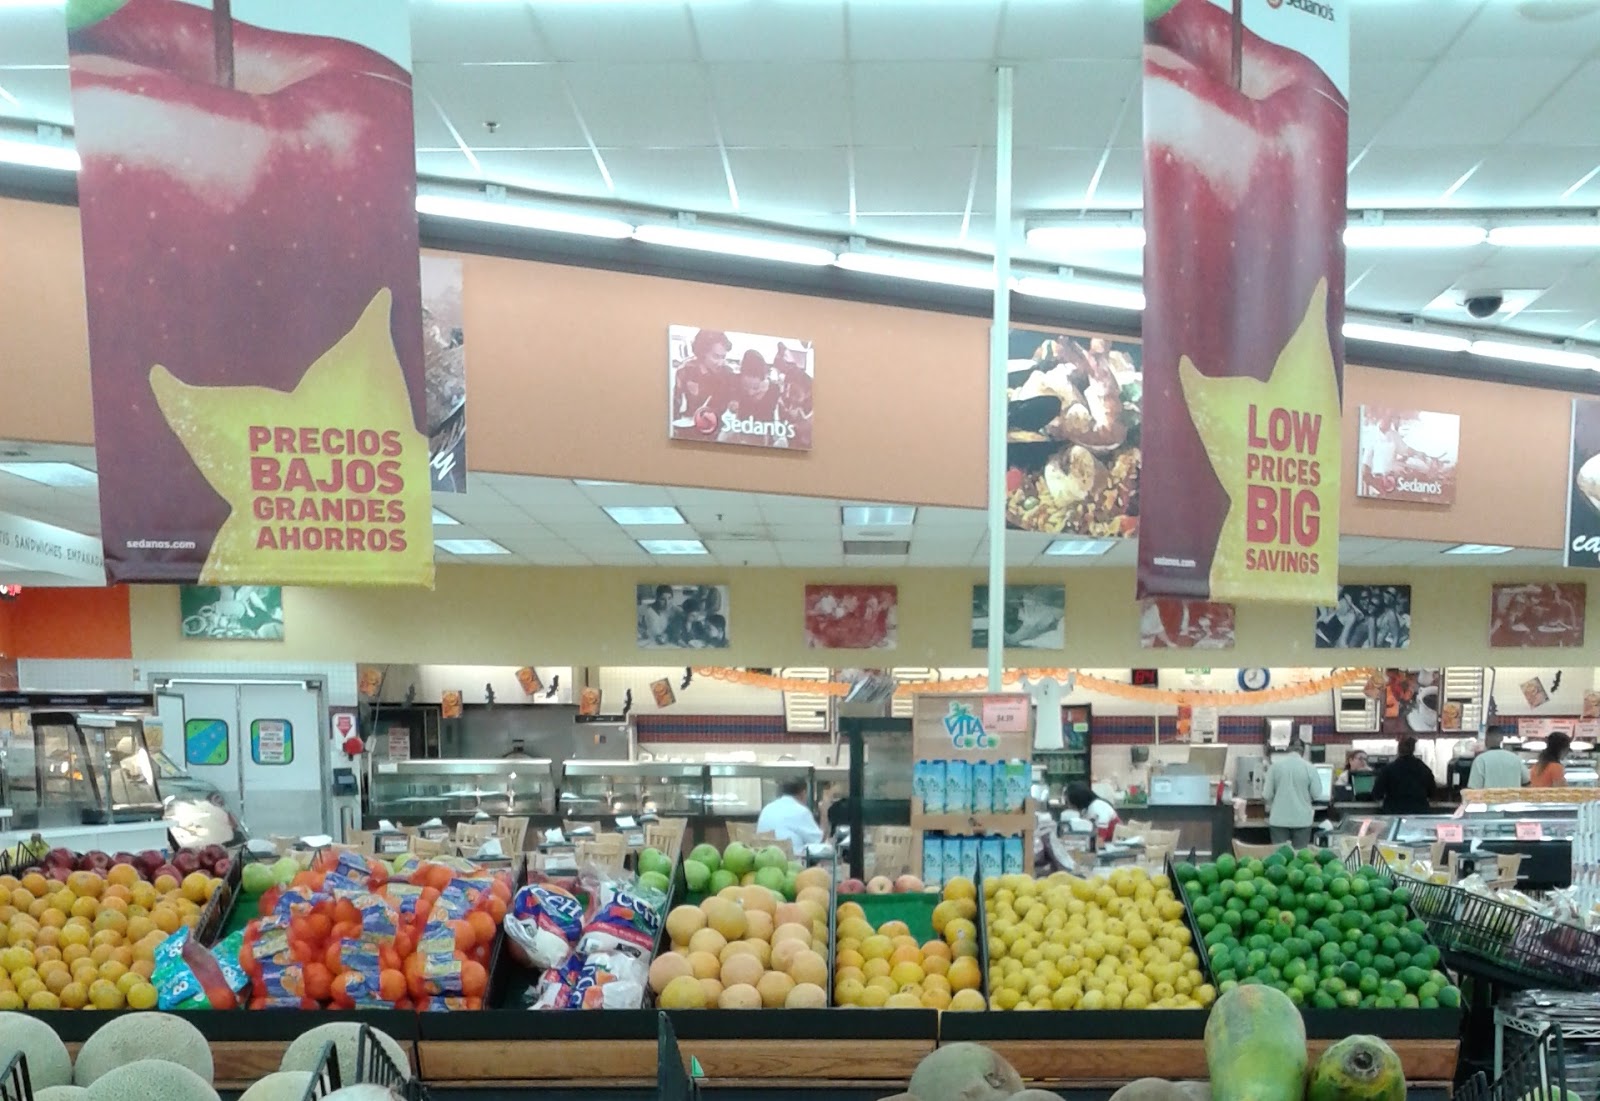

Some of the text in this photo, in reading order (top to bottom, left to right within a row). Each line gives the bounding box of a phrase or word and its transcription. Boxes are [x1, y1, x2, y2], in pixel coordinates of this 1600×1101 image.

[721, 413, 796, 438] Sedano's
[1248, 404, 1322, 455] LOW
[248, 425, 403, 457] PRECIOS
[250, 456, 405, 495] BAJOS
[1246, 453, 1321, 486] PRICES
[1397, 477, 1442, 495] Sedano's
[252, 496, 406, 524] GRANDES
[1246, 484, 1321, 547] BIG
[126, 539, 196, 549] sedanos.com
[255, 526, 408, 552] AHORROS
[1246, 548, 1320, 575] SAVINGS
